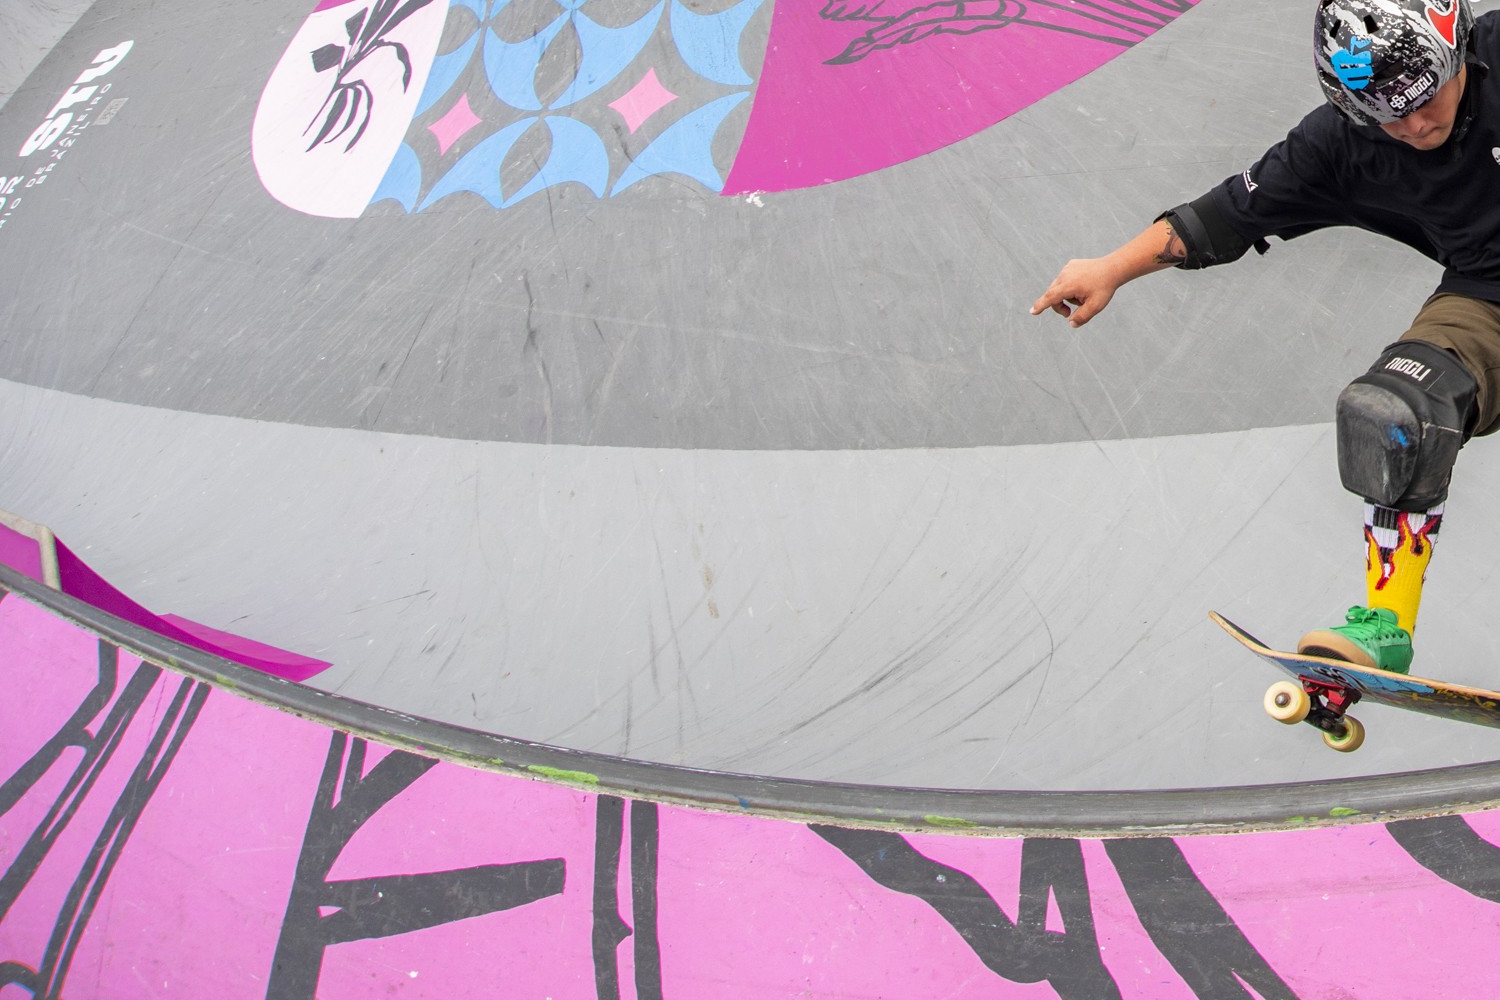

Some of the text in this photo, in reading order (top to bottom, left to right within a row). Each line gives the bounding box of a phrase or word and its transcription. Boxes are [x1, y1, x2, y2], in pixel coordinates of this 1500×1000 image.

[19, 39, 134, 157] STU
[51, 83, 112, 158] JANEIRO
[36, 121, 91, 185] BRAZIL
